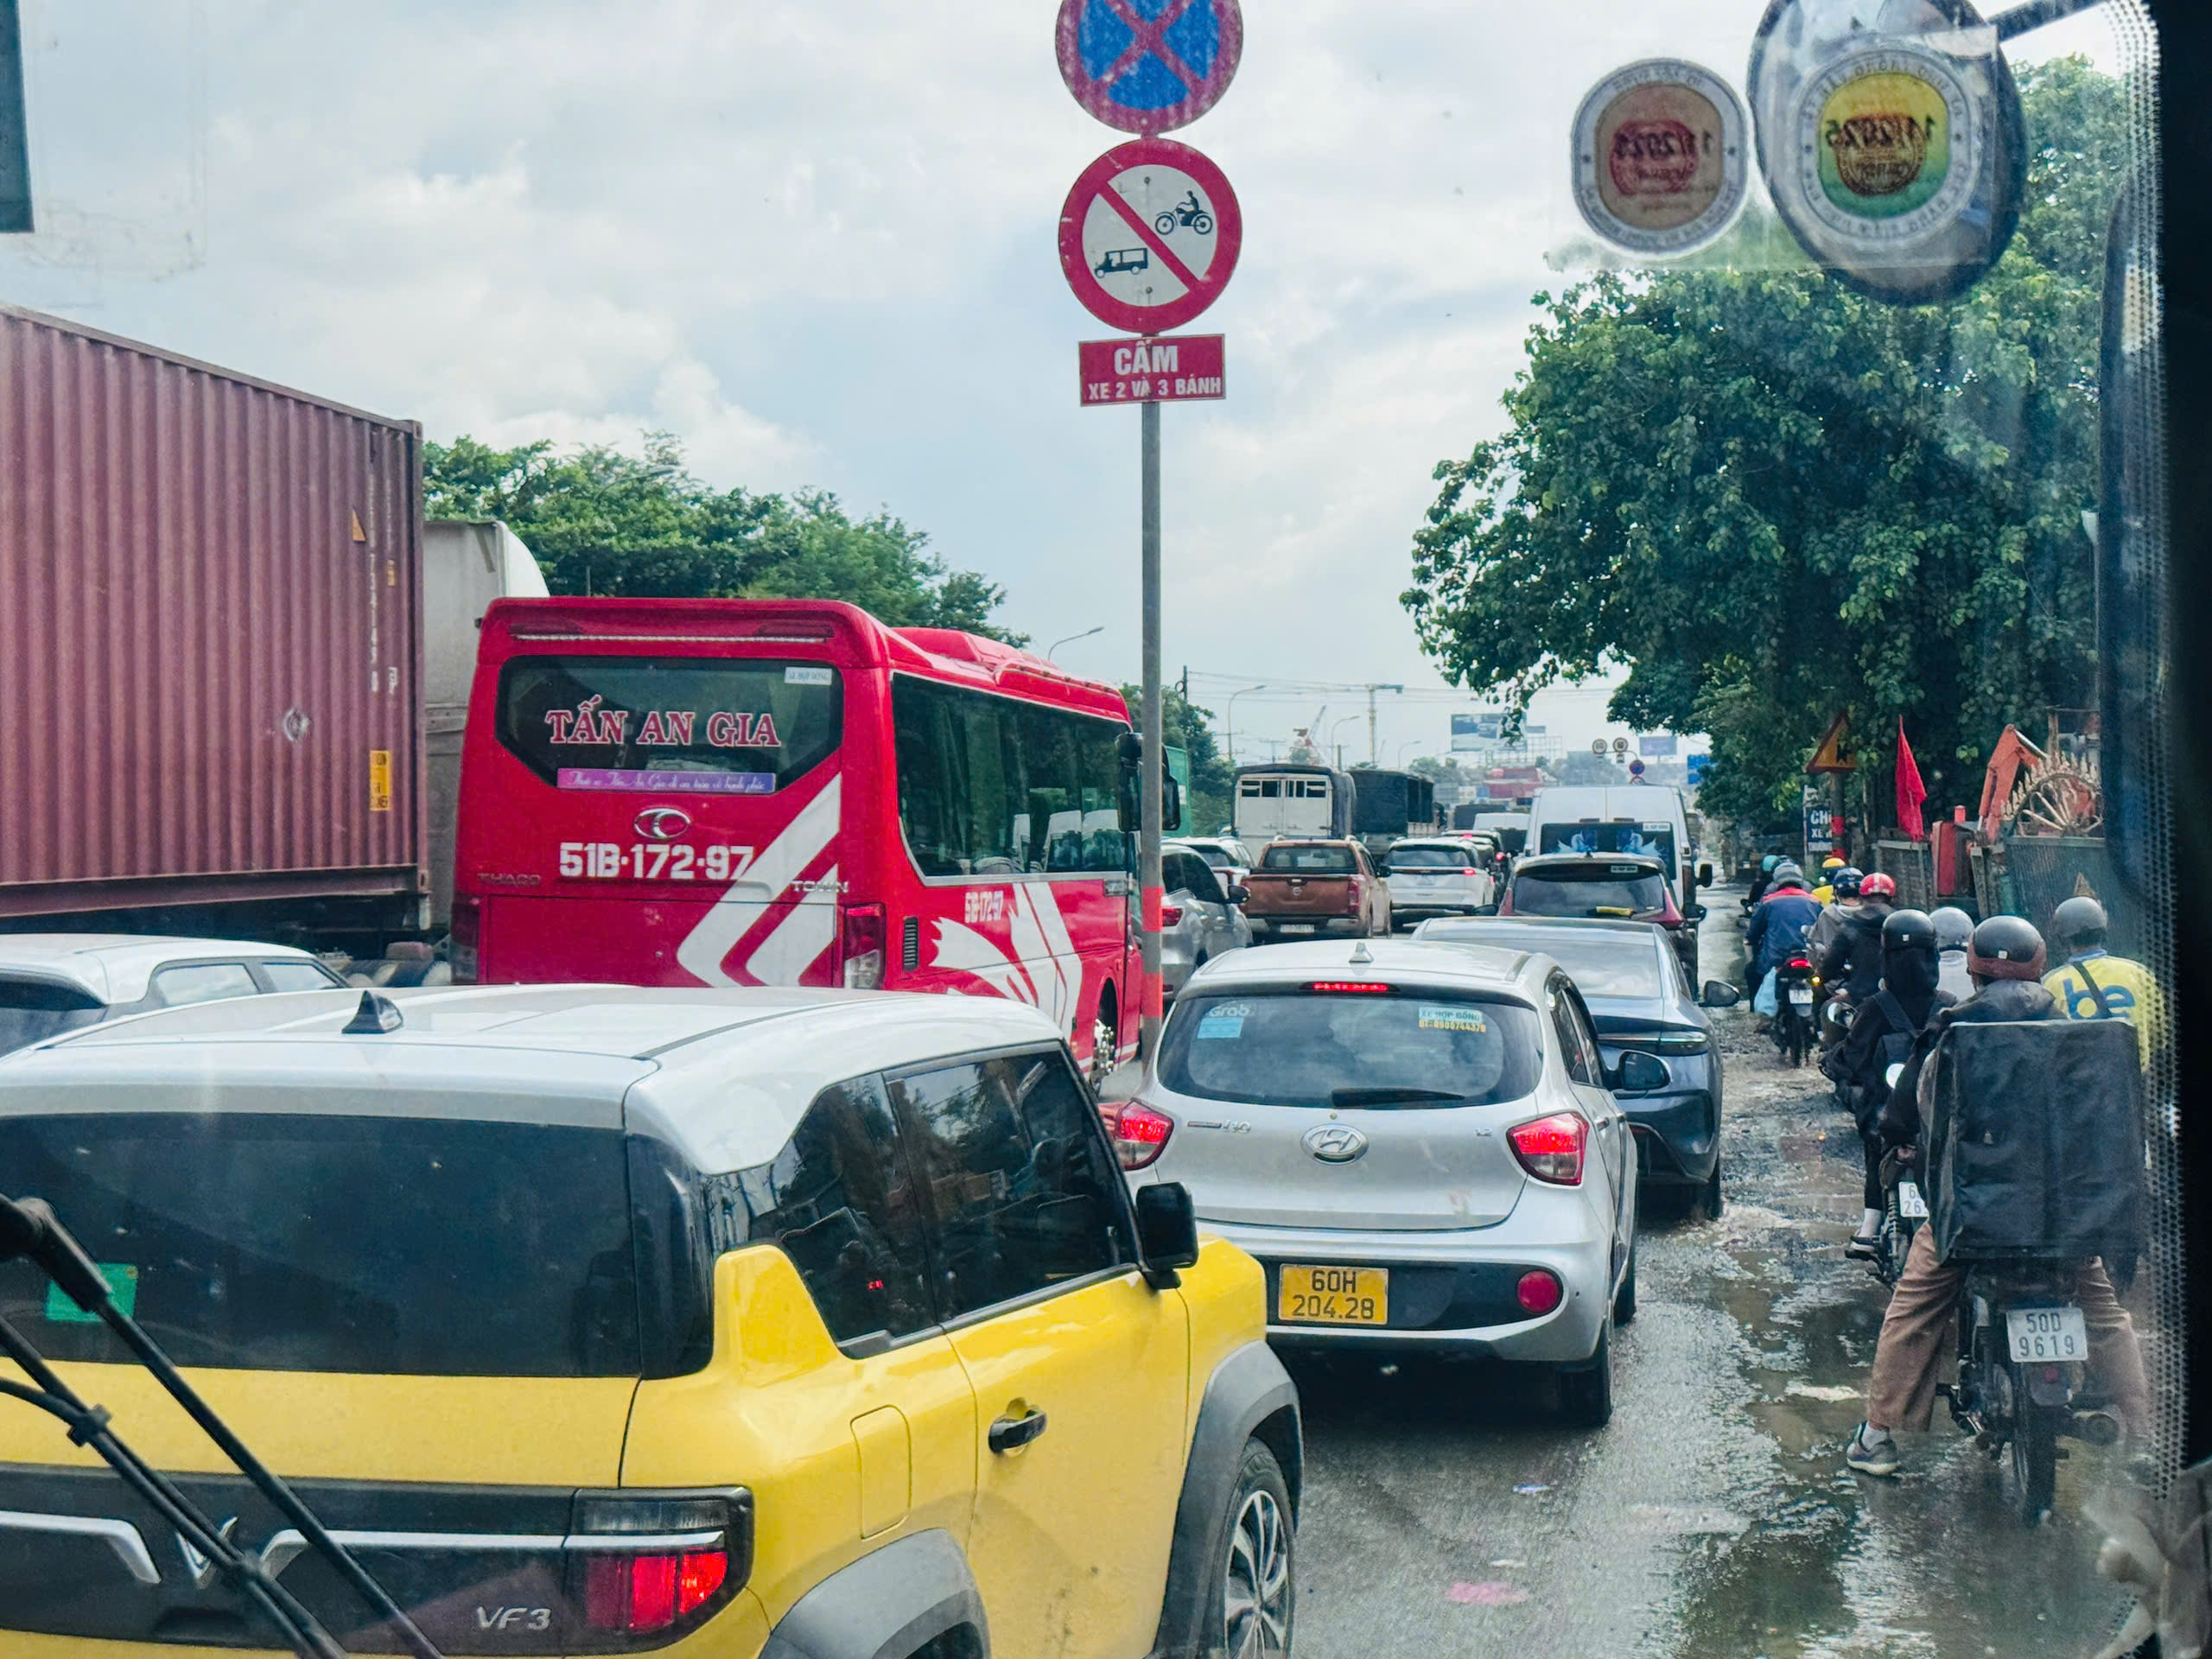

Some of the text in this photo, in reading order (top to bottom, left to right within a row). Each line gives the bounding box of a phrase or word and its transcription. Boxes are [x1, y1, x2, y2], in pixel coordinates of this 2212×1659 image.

[1114, 339, 1179, 376] CẤM
[1088, 373, 1222, 401] XE 2 VÀ 3 BÁNH
[545, 694, 782, 747] TẤN AN GIA
[789, 880, 849, 893] TOWN
[1210, 1003, 1249, 1017] Grab
[2062, 978, 2136, 1020] be
[1311, 1269, 1357, 1294] 60H
[1292, 1294, 1375, 1320] 204.28
[2018, 1333, 2075, 1357] 9619
[476, 1605, 552, 1631] VF3
